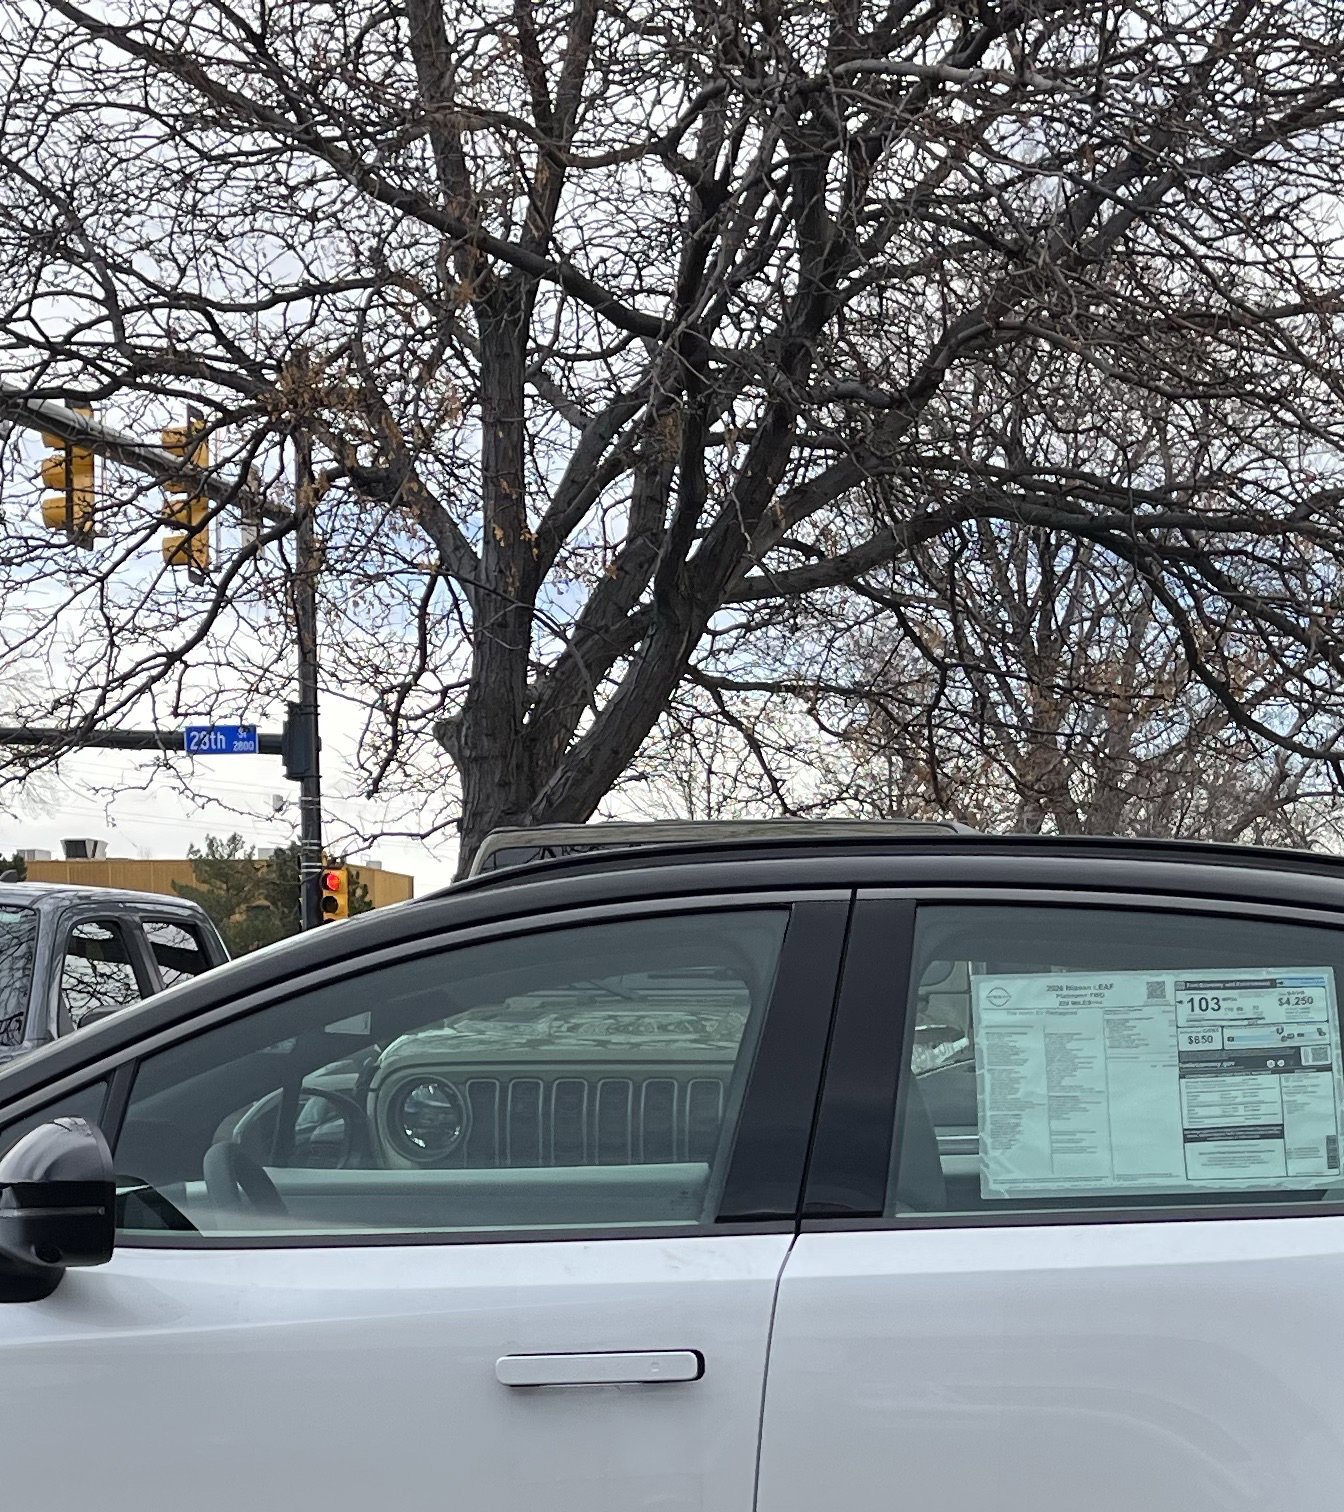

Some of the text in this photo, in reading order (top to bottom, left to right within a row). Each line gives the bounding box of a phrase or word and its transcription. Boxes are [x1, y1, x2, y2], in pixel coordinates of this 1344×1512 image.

[189, 731, 226, 750] 28th
[1187, 996, 1222, 1012] 103
[1278, 996, 1314, 1006] $4,250
[1187, 1035, 1213, 1045] $850
